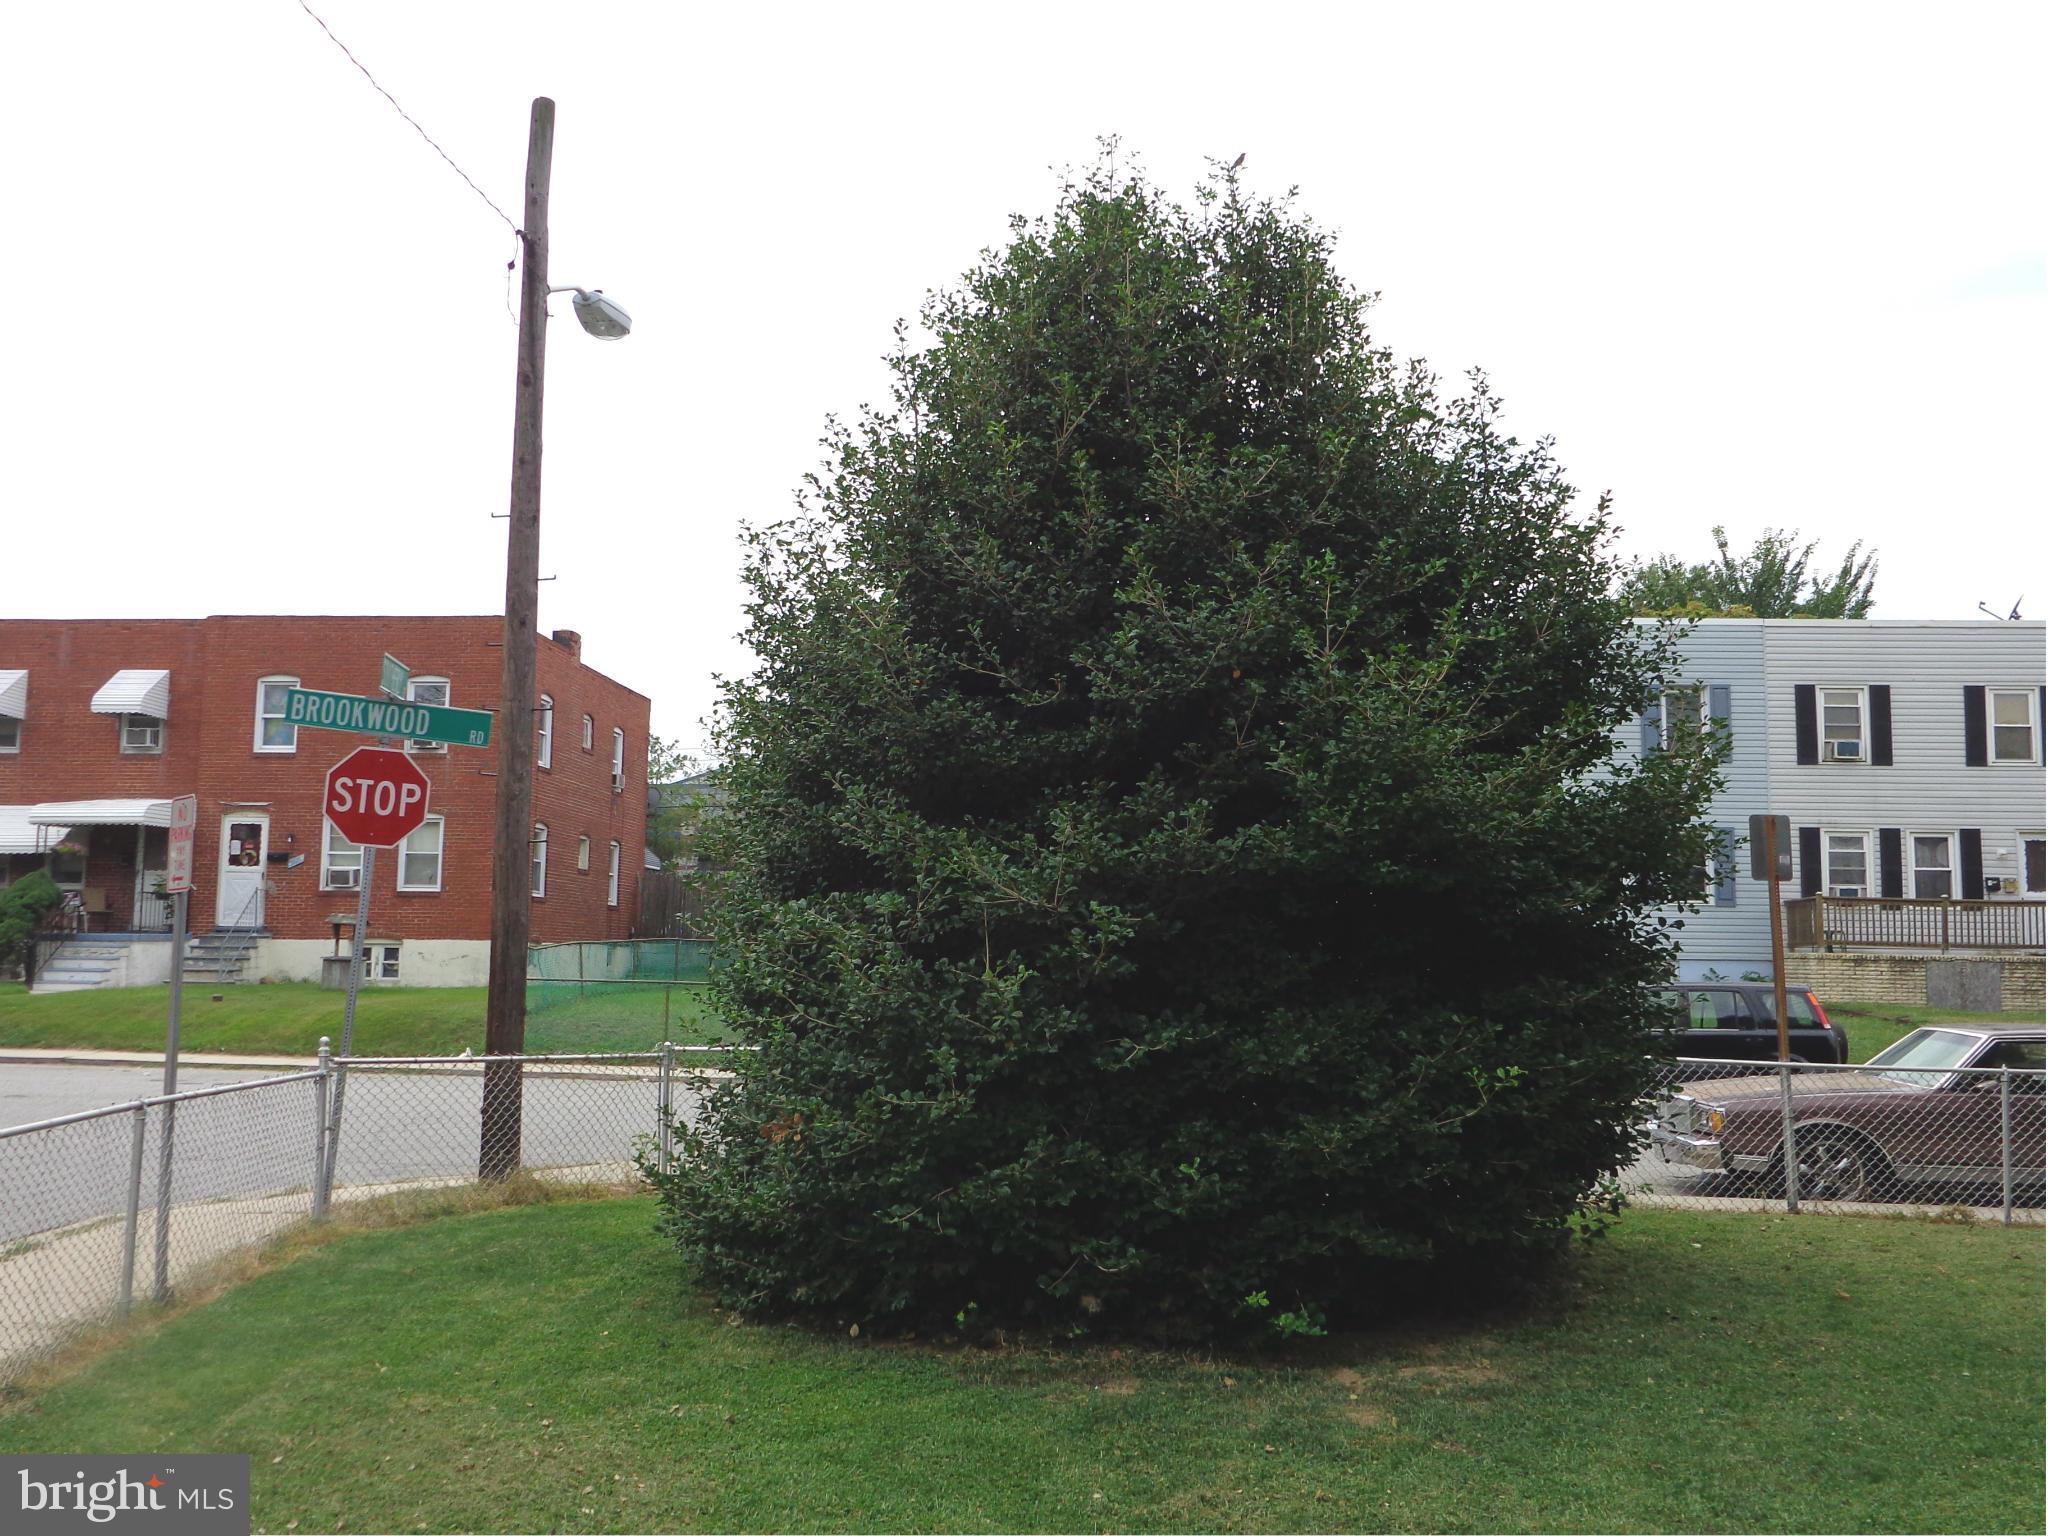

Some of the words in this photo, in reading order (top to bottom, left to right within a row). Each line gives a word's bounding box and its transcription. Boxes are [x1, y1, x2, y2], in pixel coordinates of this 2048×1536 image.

[290, 694, 431, 735] BROOKWOOD
[468, 729, 485, 745] RD
[332, 776, 422, 817] STOP
